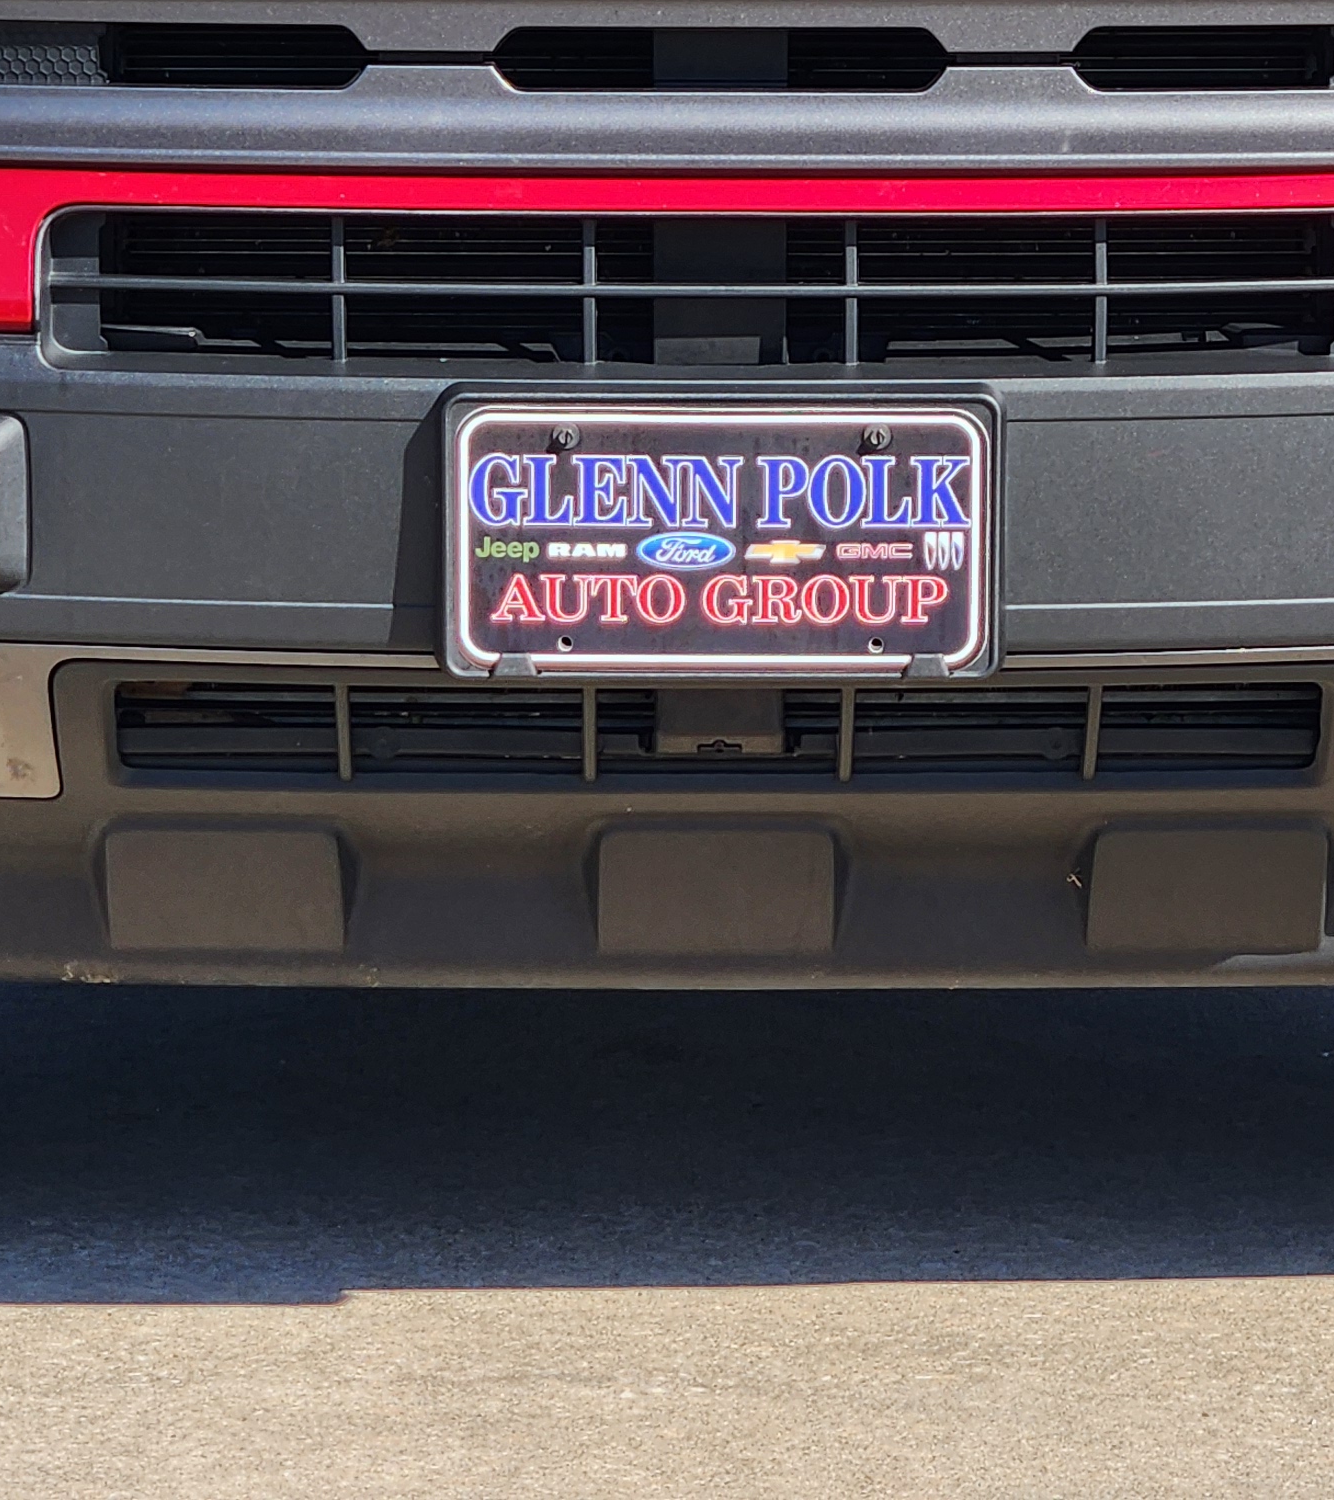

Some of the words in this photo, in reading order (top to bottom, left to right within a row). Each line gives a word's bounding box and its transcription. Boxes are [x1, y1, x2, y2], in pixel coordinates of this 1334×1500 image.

[470, 454, 743, 528] GLENN
[756, 454, 971, 528] POLK
[475, 536, 540, 562] Jeep
[547, 542, 628, 560] RAM
[655, 536, 716, 564] Ford
[836, 542, 914, 559] GMC
[491, 575, 686, 624] AUTO
[702, 574, 948, 625] GROUP
